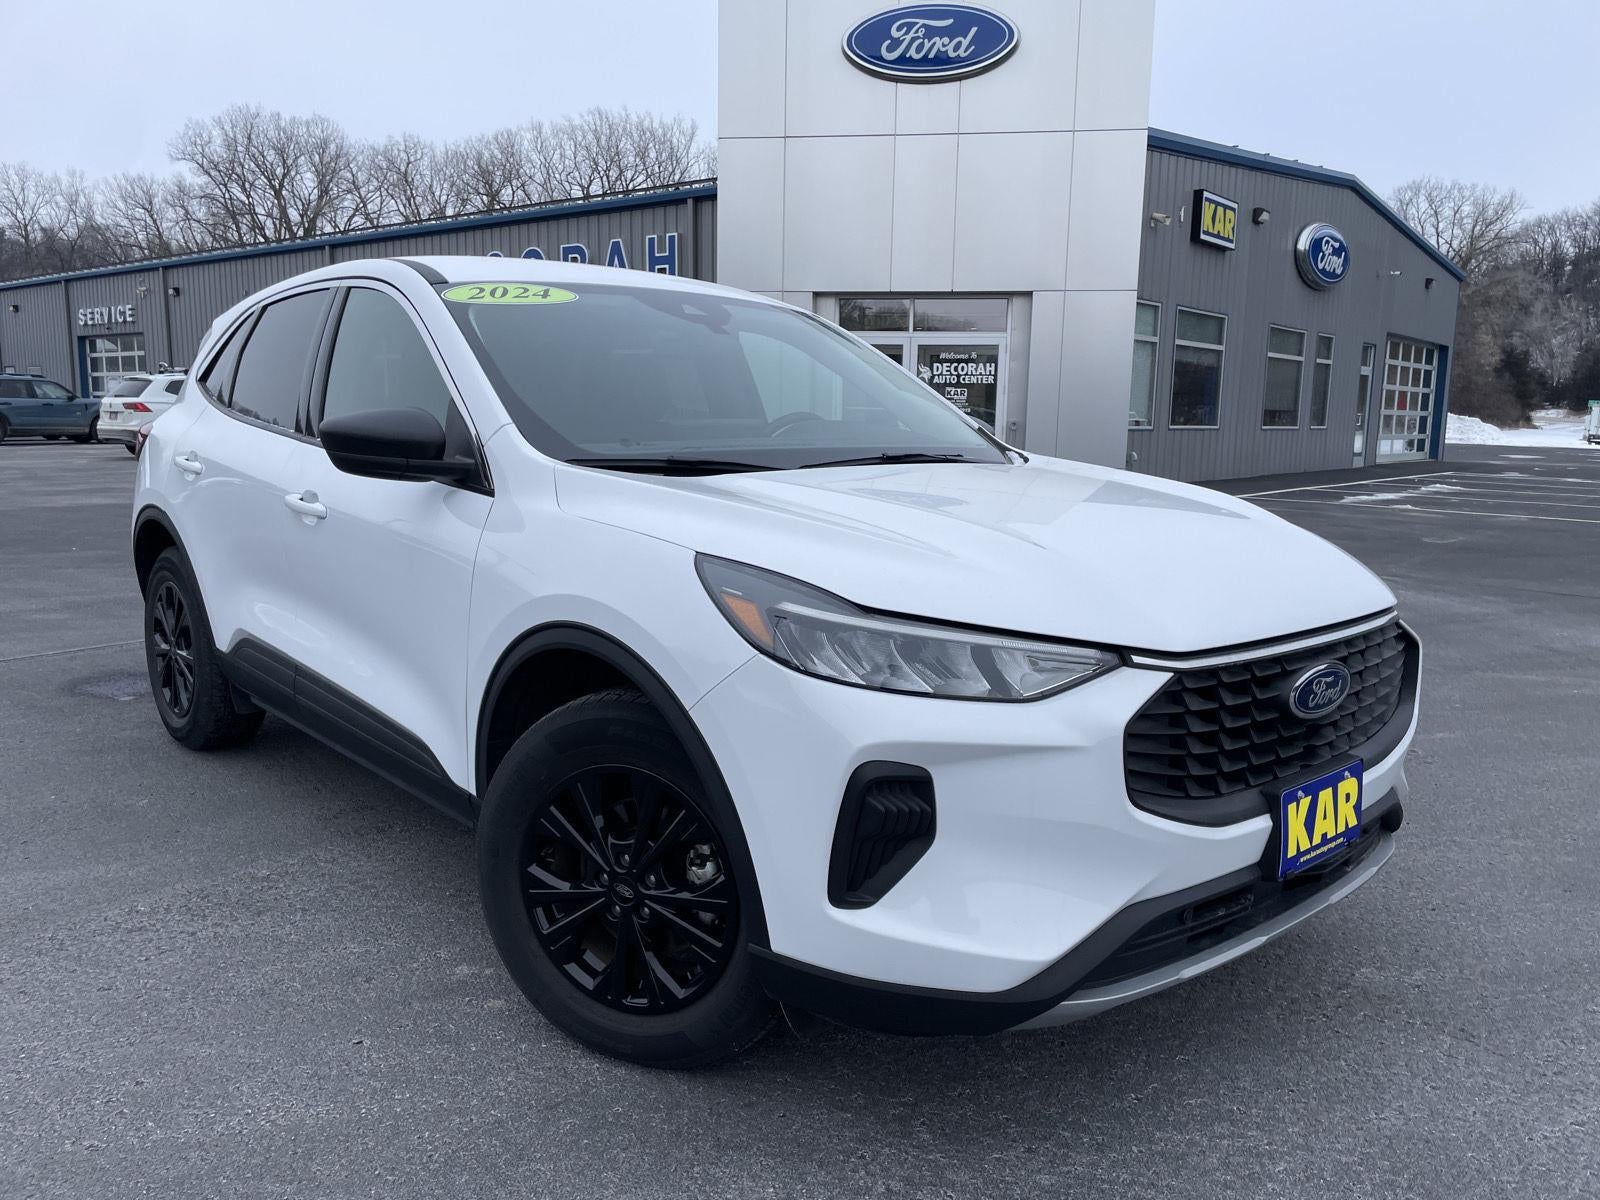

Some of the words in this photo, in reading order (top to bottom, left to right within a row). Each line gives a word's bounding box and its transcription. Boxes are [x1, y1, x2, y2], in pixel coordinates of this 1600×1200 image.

[880, 18, 978, 61] Ford
[1203, 201, 1235, 240] KAR
[1317, 236, 1345, 275] Ford
[467, 286, 551, 300] 2024
[78, 304, 133, 326] SERVICE
[939, 352, 969, 360] Welcome
[932, 362, 996, 375] DECORAH
[932, 375, 958, 384] AUTO
[960, 375, 995, 384] CENTER
[945, 389, 967, 397] KAR
[1308, 675, 1342, 708] Ford
[1287, 777, 1359, 859] KAR
